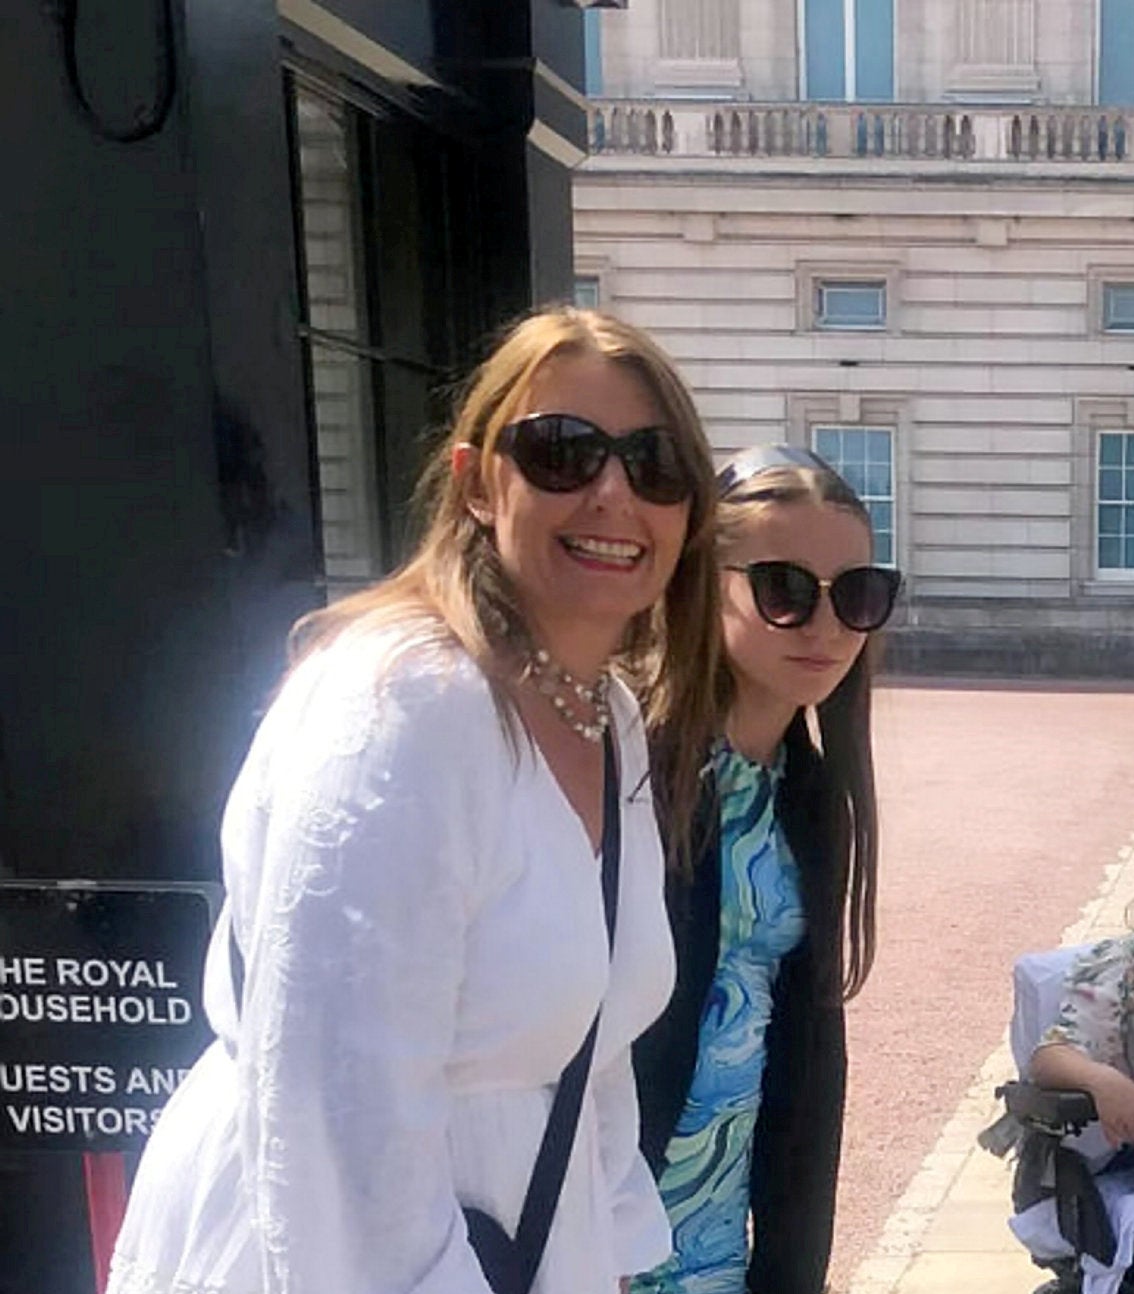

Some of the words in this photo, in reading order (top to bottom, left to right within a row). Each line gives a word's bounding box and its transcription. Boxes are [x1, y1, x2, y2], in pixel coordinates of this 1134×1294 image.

[57, 959, 177, 989] ROYAL
[0, 993, 192, 1025] OUSEHOLD
[1, 1064, 116, 1093] UESTS
